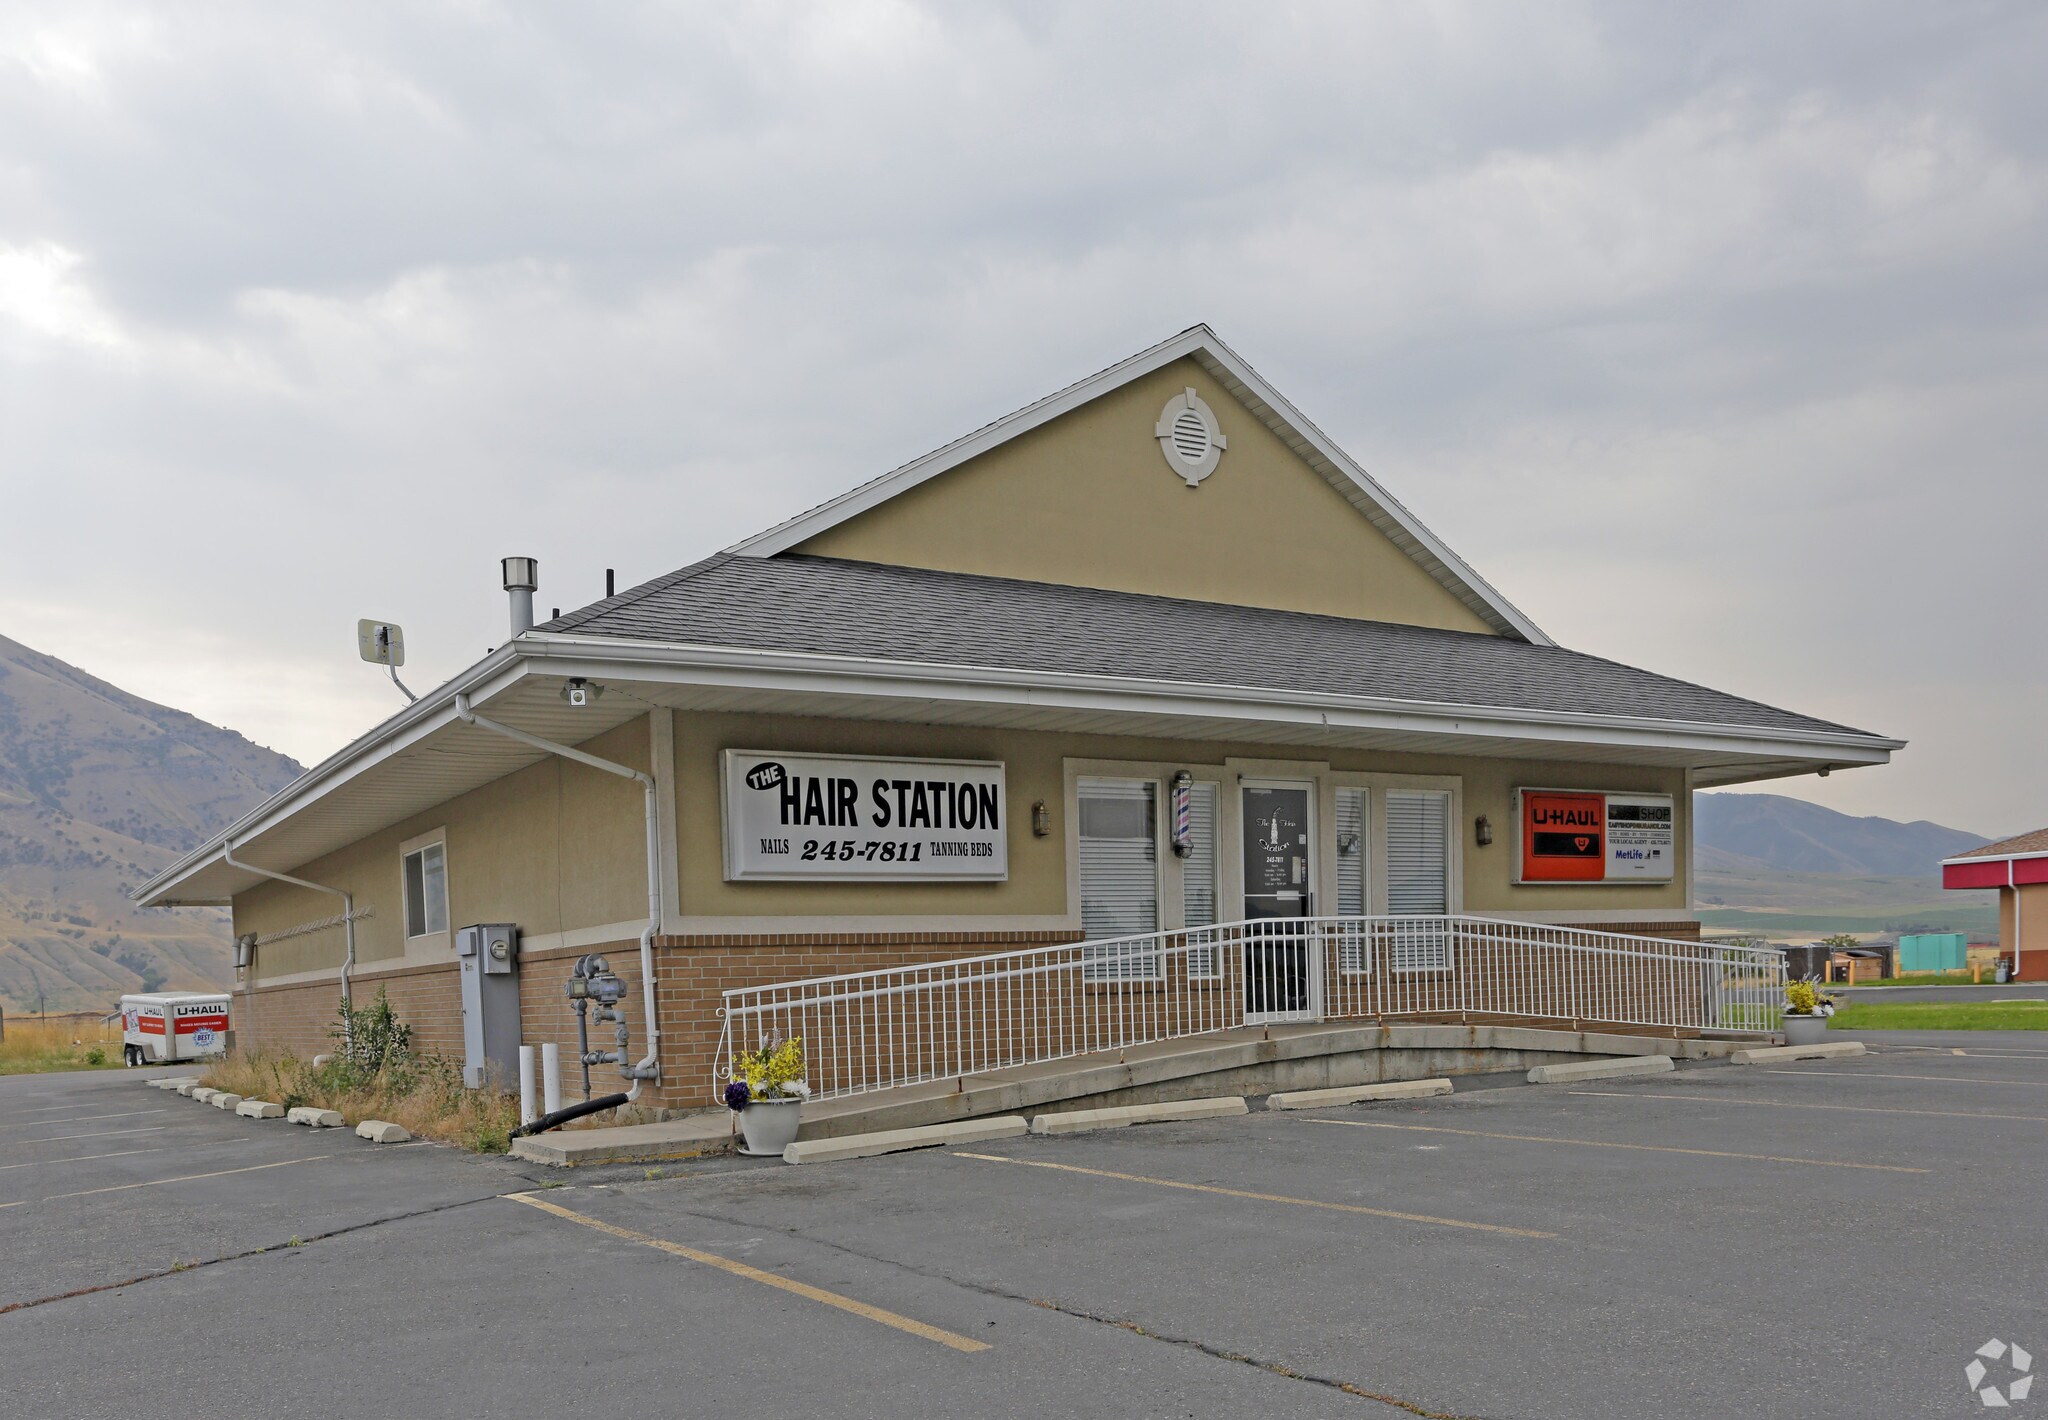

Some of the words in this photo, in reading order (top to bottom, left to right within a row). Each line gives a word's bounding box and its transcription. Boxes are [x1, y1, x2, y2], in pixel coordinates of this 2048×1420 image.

[750, 765, 781, 790] THE
[780, 776, 859, 827] HAIR
[872, 778, 999, 830] STATION
[1533, 808, 1599, 826] U-HAUL
[1641, 807, 1670, 820] SHOP
[760, 838, 790, 854] NAILS
[800, 839, 922, 862] 245-7811
[930, 841, 969, 857] TANNING
[970, 842, 993, 857] BEDS
[1615, 849, 1643, 860] MetLife
[177, 1005, 225, 1016] U-HAUL
